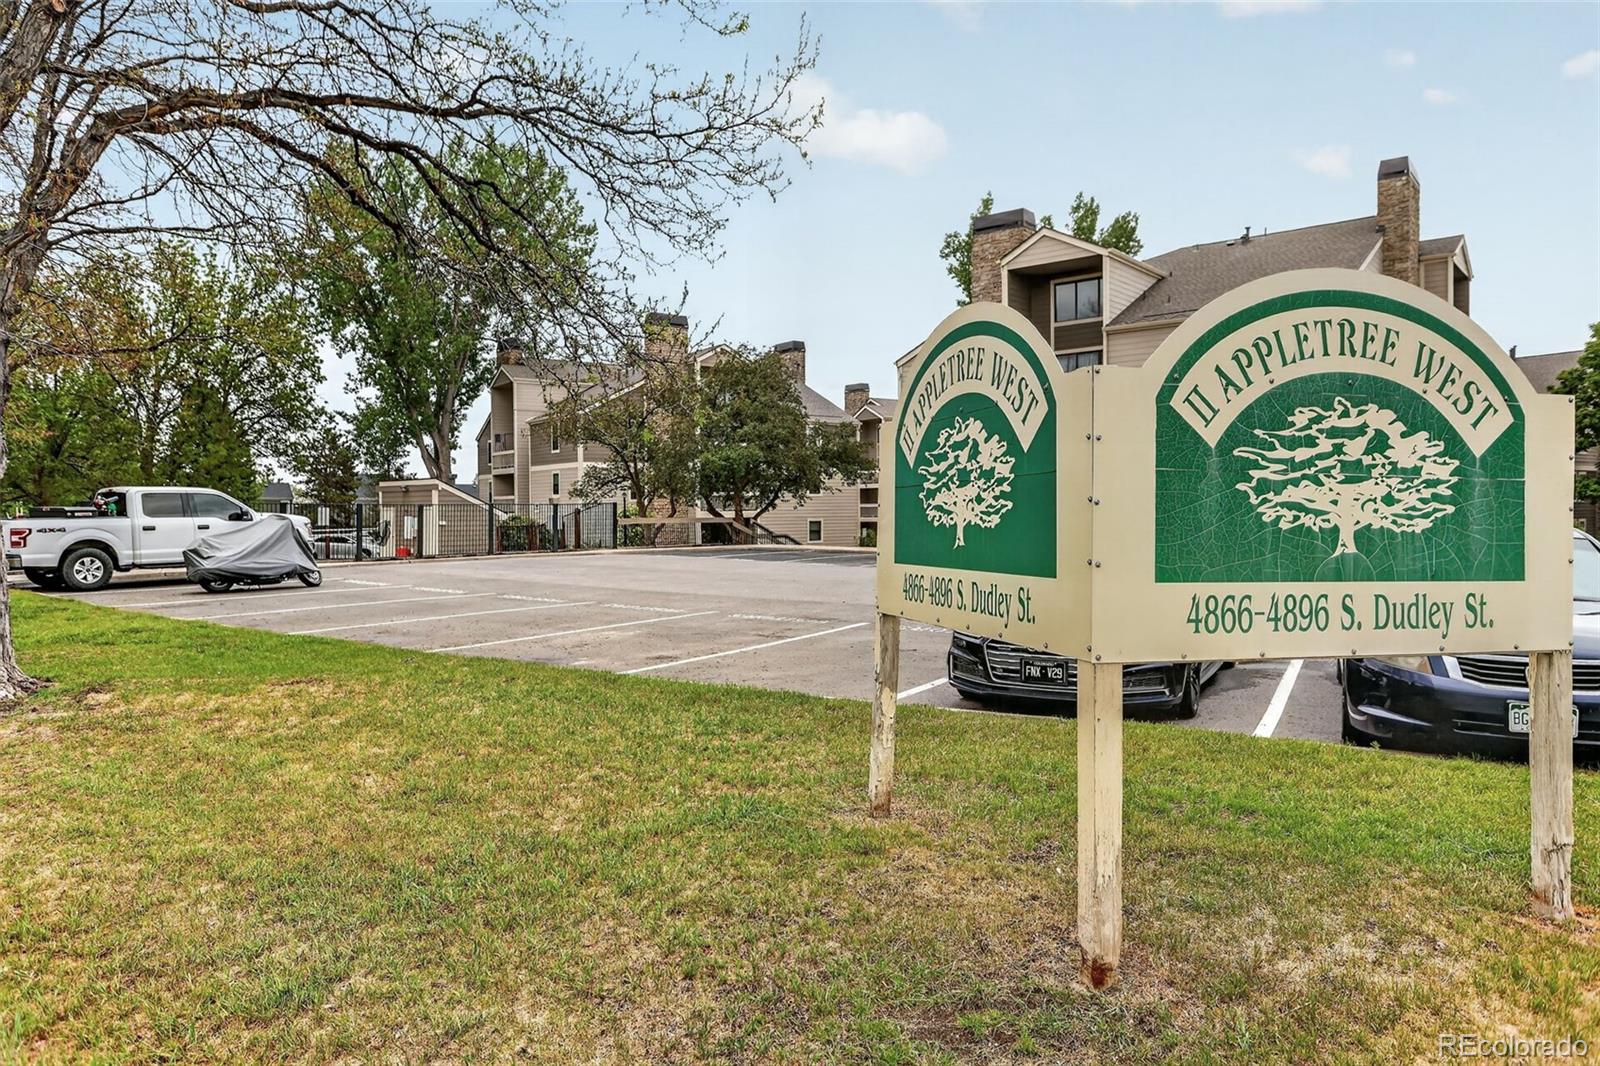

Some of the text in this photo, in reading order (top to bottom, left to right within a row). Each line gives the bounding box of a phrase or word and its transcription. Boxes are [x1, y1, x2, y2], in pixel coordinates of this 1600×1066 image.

[914, 347, 985, 429] APPLETREE
[990, 350, 1039, 427] WEST
[1183, 318, 1499, 431] II APPLETREE WEST
[902, 572, 1037, 628] 4866-4896 S. Dudley St.
[1187, 592, 1495, 640] 4866-4896 S. Dudley St.
[1025, 665, 1063, 679] FNX V29
[1513, 711, 1529, 726] BG
